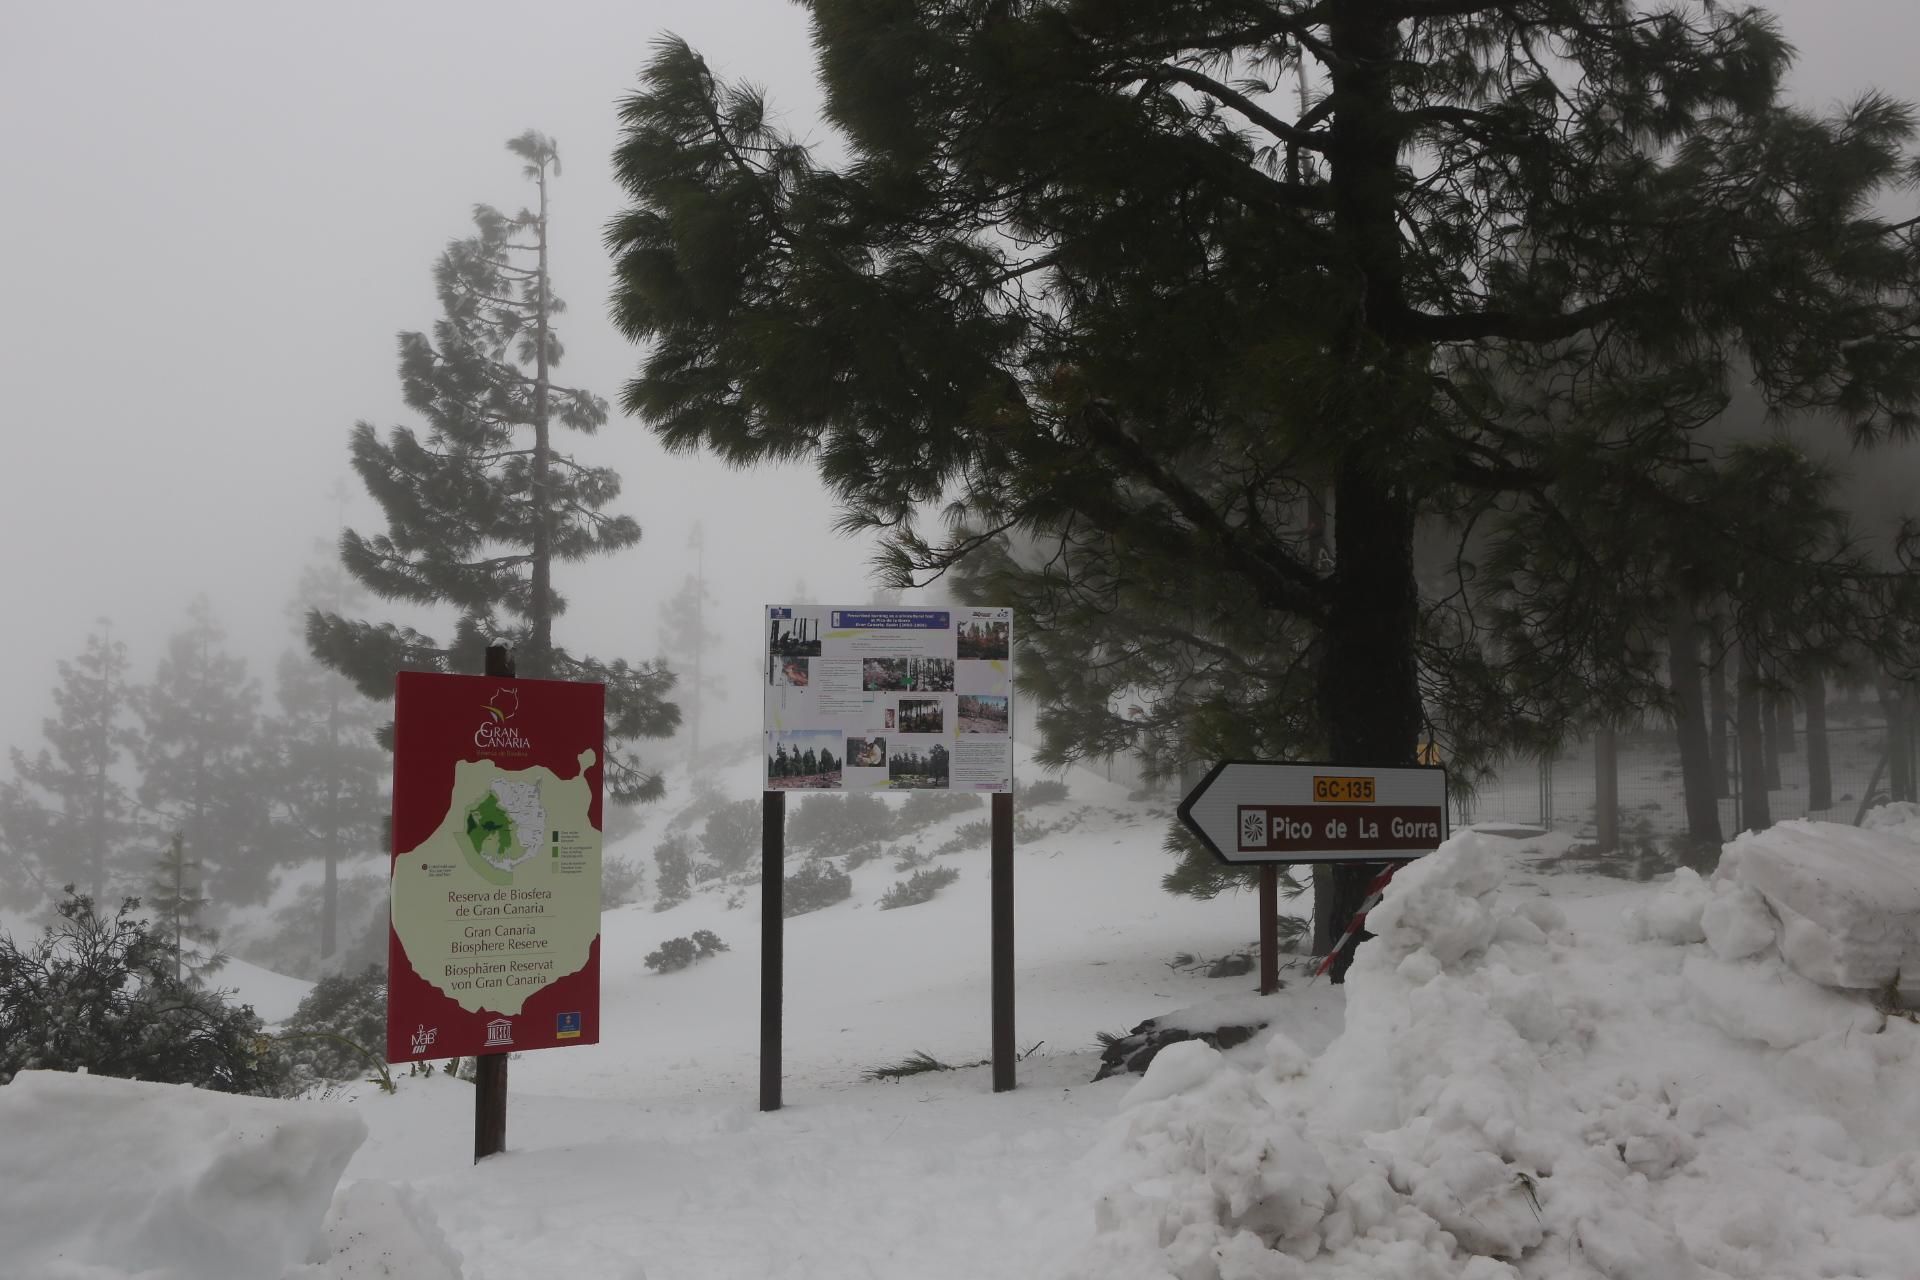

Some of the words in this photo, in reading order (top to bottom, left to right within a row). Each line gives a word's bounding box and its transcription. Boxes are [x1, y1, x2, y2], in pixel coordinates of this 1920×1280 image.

[474, 729, 530, 748] CANARIA
[1272, 816, 1312, 839] Pico
[1325, 818, 1348, 839] de
[1359, 817, 1379, 839] La
[1391, 816, 1438, 839] Gorra
[448, 891, 490, 903] Reserva
[493, 889, 507, 901] de
[510, 888, 552, 900] Biosfera
[455, 905, 470, 917] de
[473, 904, 500, 916] Gran
[503, 902, 544, 915] Canaria
[464, 926, 491, 938] Gran
[494, 924, 536, 937] Canaria
[451, 941, 505, 955] Biosphere
[508, 938, 548, 951] Reserve
[444, 962, 506, 978] Biosphären
[509, 960, 553, 972] Reservat
[451, 980, 472, 990] von
[475, 976, 503, 989] Gran
[505, 973, 547, 986] Canaria
[487, 1025, 512, 1040] UNESCO
